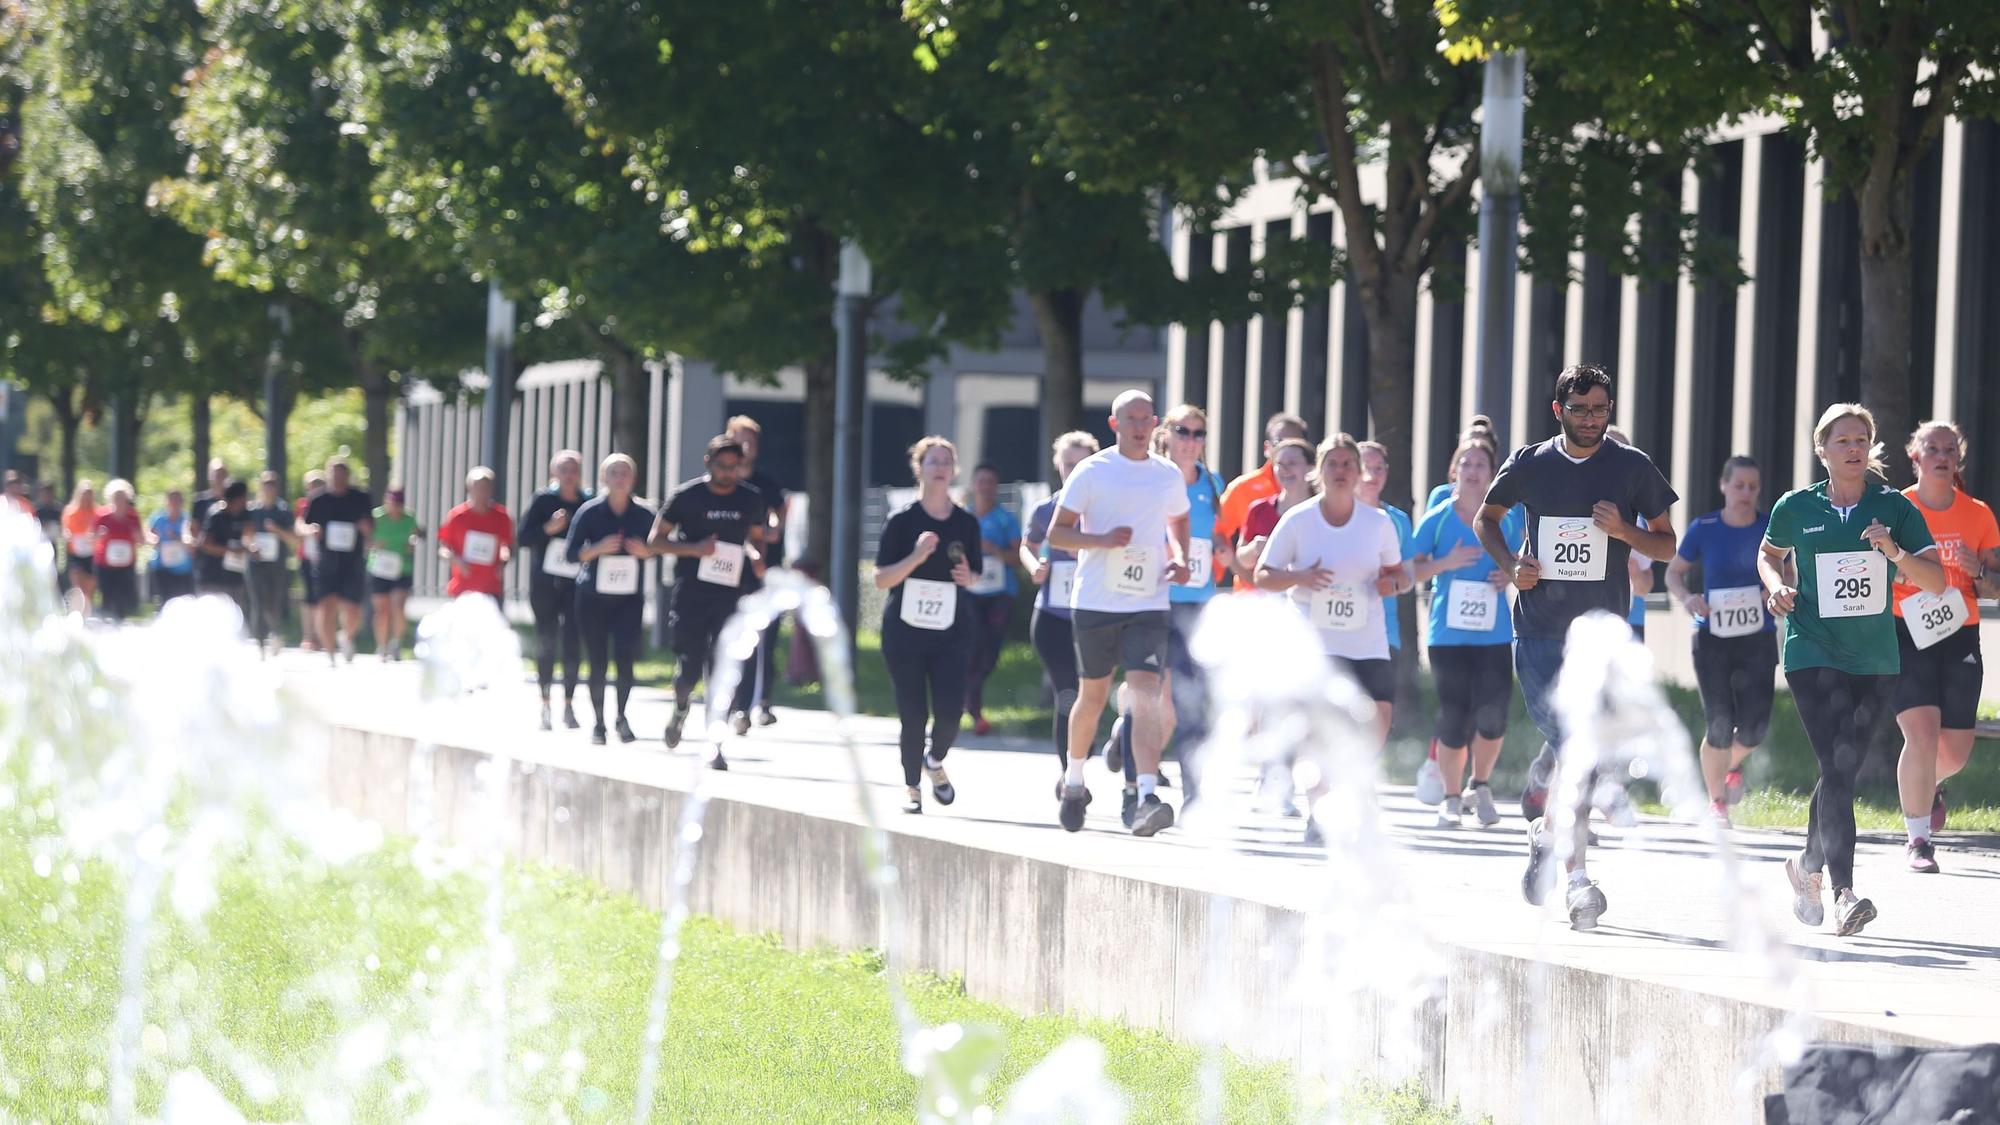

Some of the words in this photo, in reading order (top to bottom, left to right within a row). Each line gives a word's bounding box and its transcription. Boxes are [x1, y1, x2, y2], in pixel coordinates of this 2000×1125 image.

[1802, 524, 1825, 535] hummel
[1554, 542, 1591, 564] 205
[1123, 565, 1144, 581] 40
[1558, 568, 1587, 577] Nagaraj
[1834, 577, 1872, 600] 295
[917, 599, 943, 615] 127
[1326, 600, 1354, 617] 105
[1460, 600, 1487, 617] 223
[1843, 604, 1865, 612] Sarah
[1714, 606, 1760, 628] 1703
[1921, 604, 1954, 630] 338
